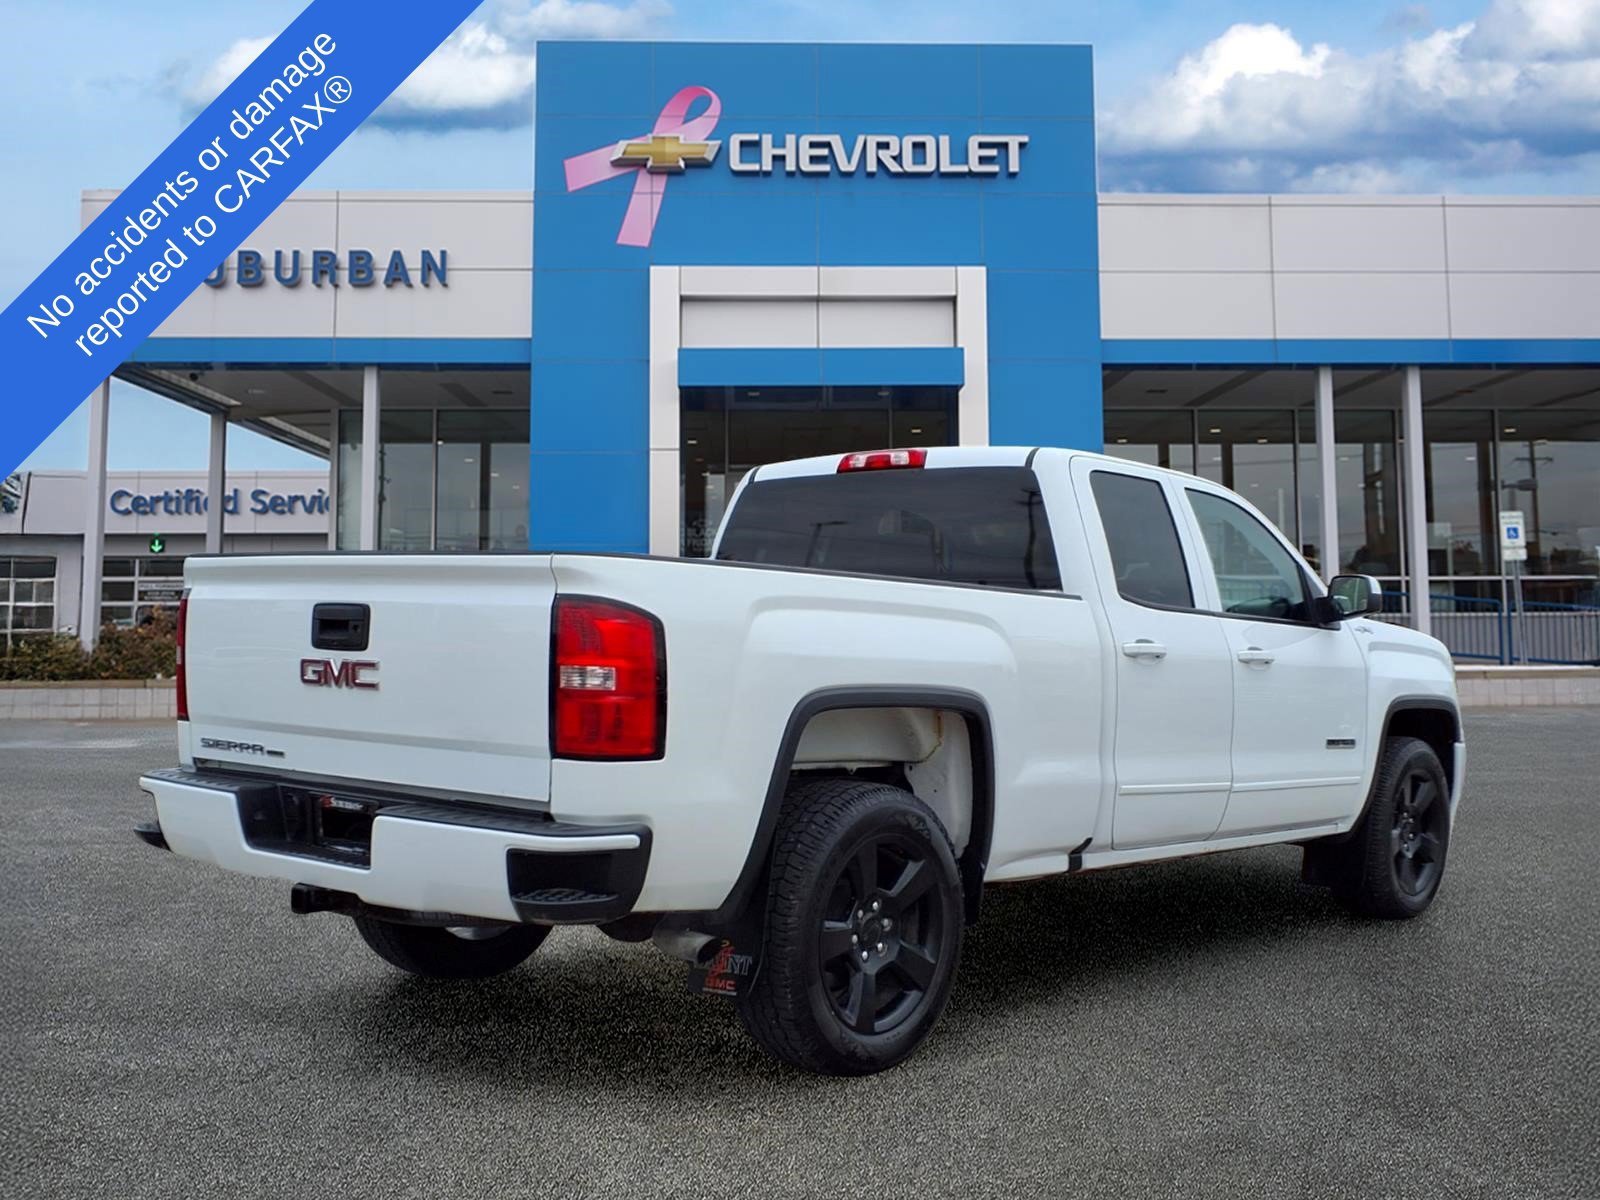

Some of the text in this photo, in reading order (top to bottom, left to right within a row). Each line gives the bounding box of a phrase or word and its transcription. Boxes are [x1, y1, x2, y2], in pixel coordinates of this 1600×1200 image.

[729, 133, 1029, 175] CHEVROLET
[203, 248, 449, 288] UBURBAN
[109, 488, 329, 516] Certifid Servi
[300, 658, 379, 690] GMC
[201, 737, 265, 756] SIERRA
